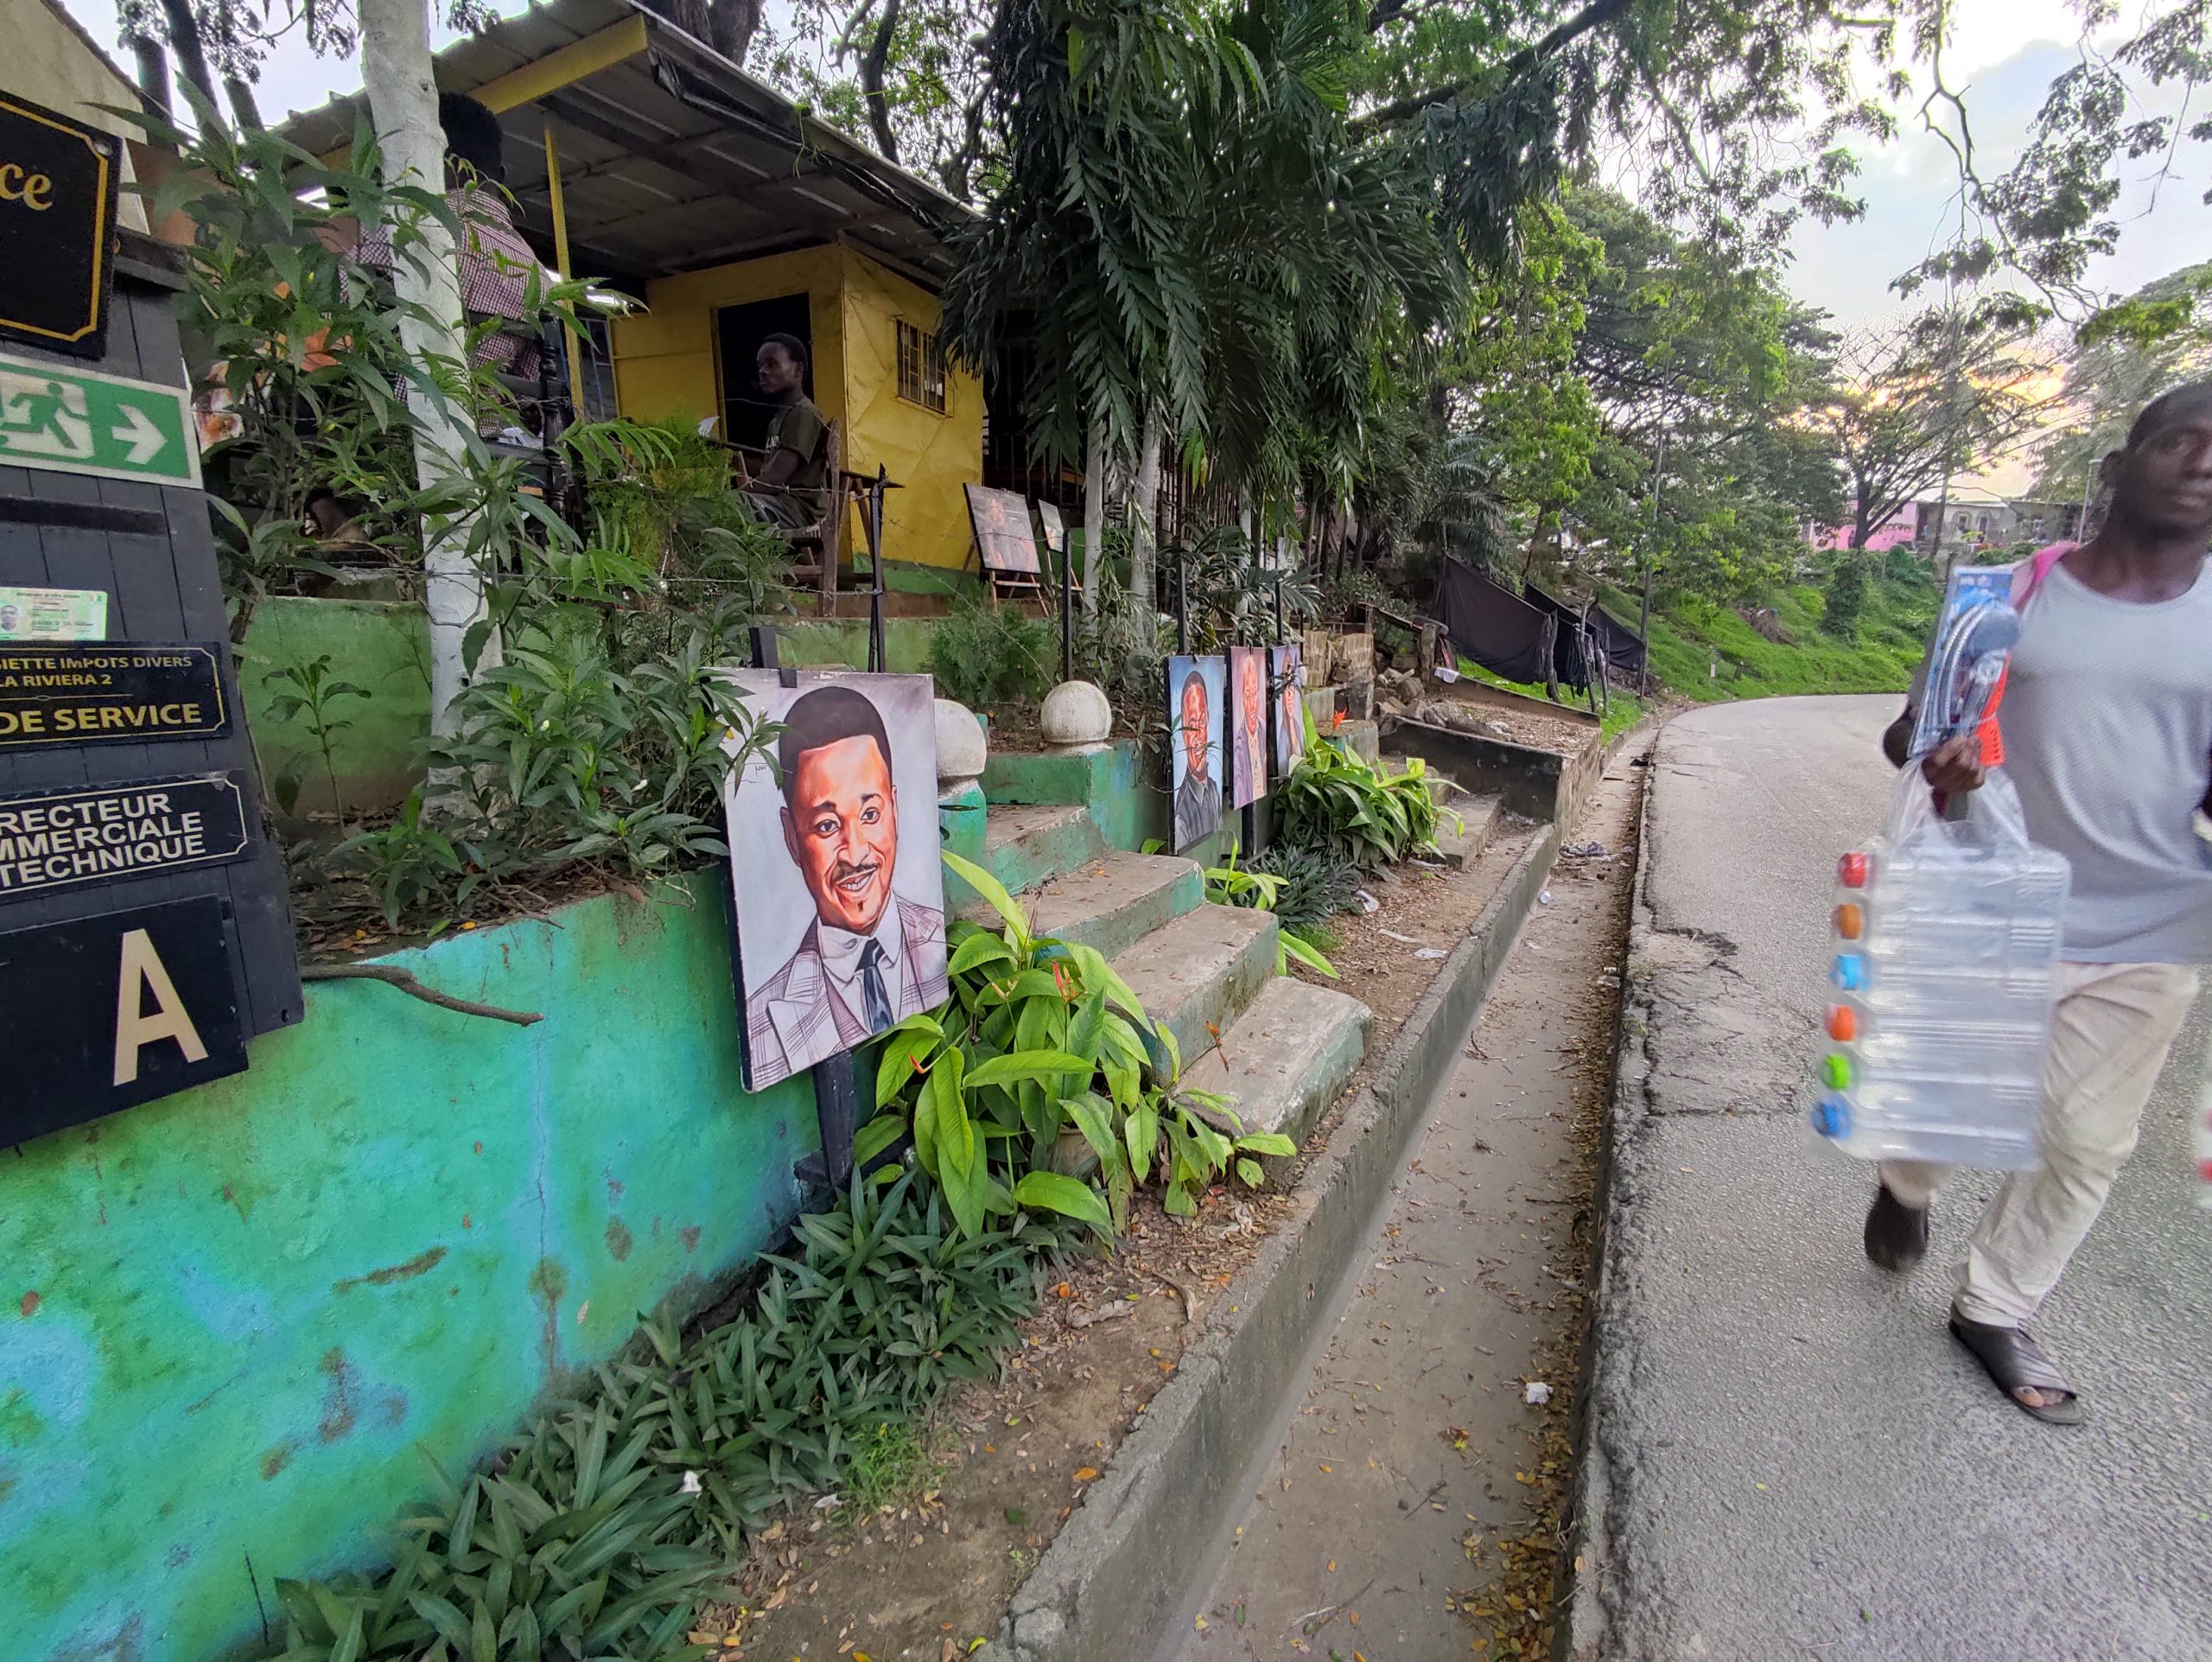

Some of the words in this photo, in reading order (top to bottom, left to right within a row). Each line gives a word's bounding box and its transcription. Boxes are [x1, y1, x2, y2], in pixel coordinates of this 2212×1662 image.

[0, 658, 57, 670] IETTE
[60, 657, 130, 669] IMPOTS
[132, 657, 193, 668] DIVERS
[22, 674, 98, 686] RIVIERA
[101, 674, 112, 685] 2
[0, 710, 46, 735] DE
[54, 703, 202, 731] SERVICE
[0, 793, 173, 836] RECTEUR
[0, 834, 207, 888] TECHNIQUE
[113, 928, 209, 1086] A
